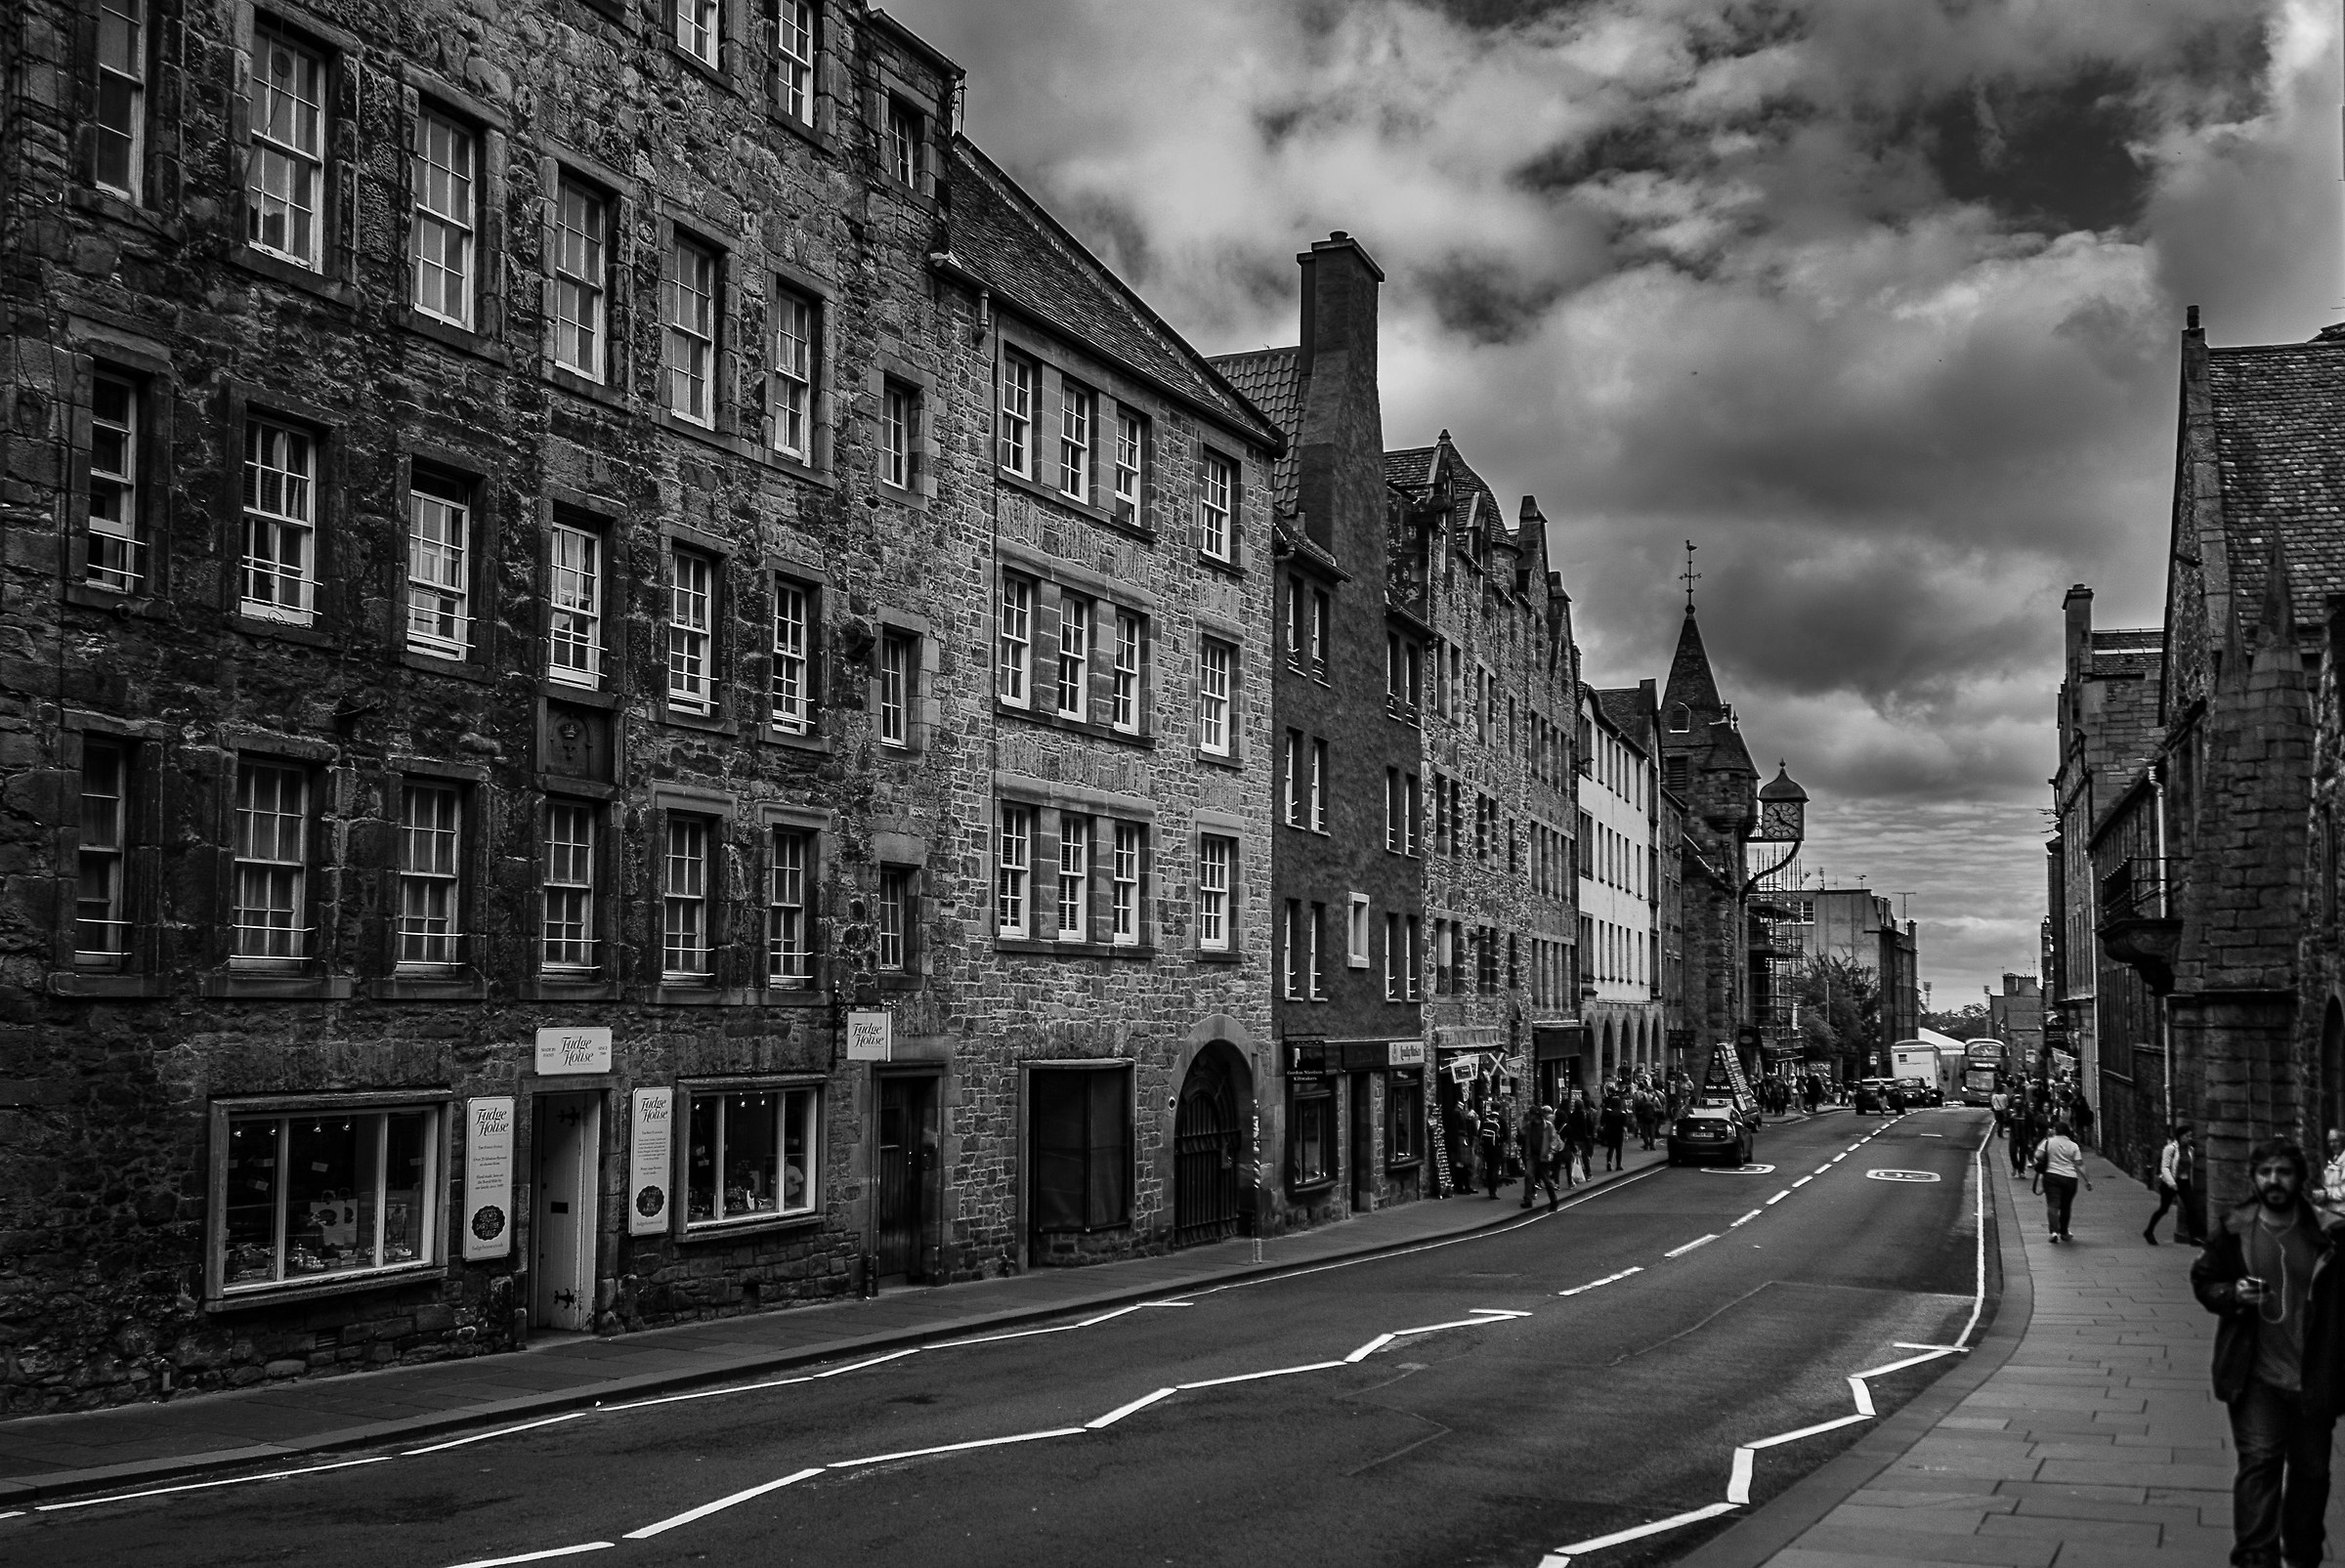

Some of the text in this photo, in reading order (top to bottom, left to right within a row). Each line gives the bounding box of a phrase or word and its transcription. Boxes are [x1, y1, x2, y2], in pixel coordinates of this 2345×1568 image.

[852, 1022, 882, 1038] Fudge
[559, 1036, 592, 1054] Fudge
[855, 1034, 884, 1047] House
[563, 1049, 594, 1066] House
[639, 1097, 666, 1113] Fudge
[475, 1107, 507, 1125] Fudge
[641, 1109, 668, 1123] House
[478, 1121, 509, 1137] House
